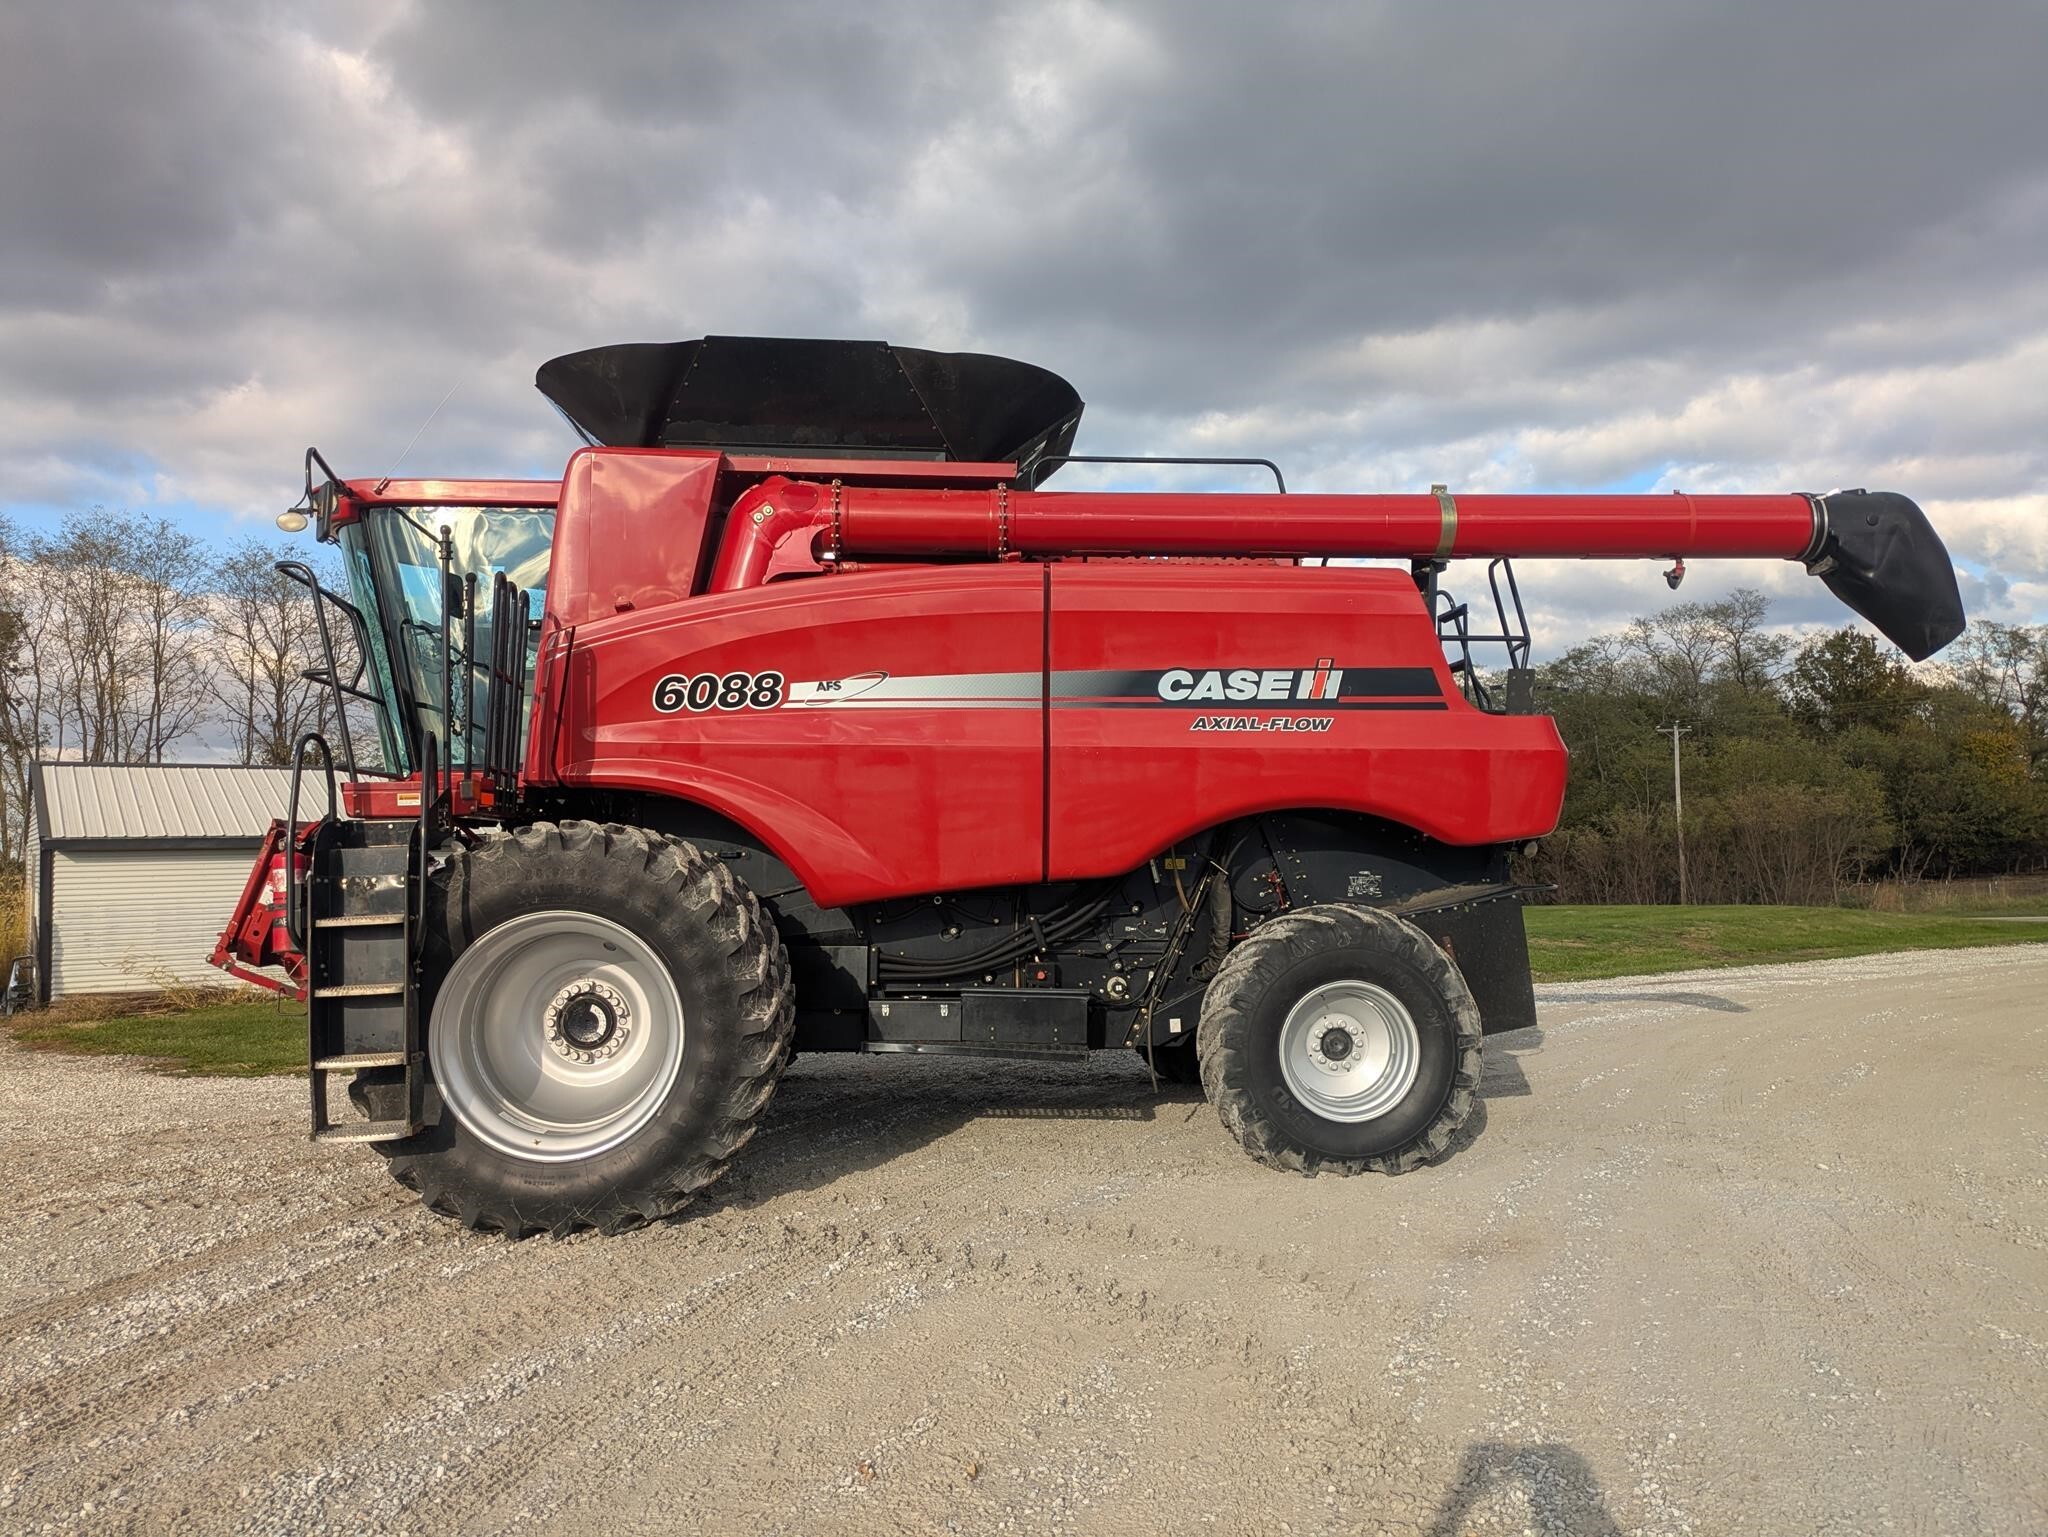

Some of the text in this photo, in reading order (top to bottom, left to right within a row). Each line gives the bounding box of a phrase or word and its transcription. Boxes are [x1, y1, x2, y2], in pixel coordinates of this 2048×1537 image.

[653, 671, 785, 713] 6088
[816, 680, 842, 691] AFS
[1158, 669, 1294, 701] CASE
[1190, 716, 1334, 732] AXIAL-FLOW
